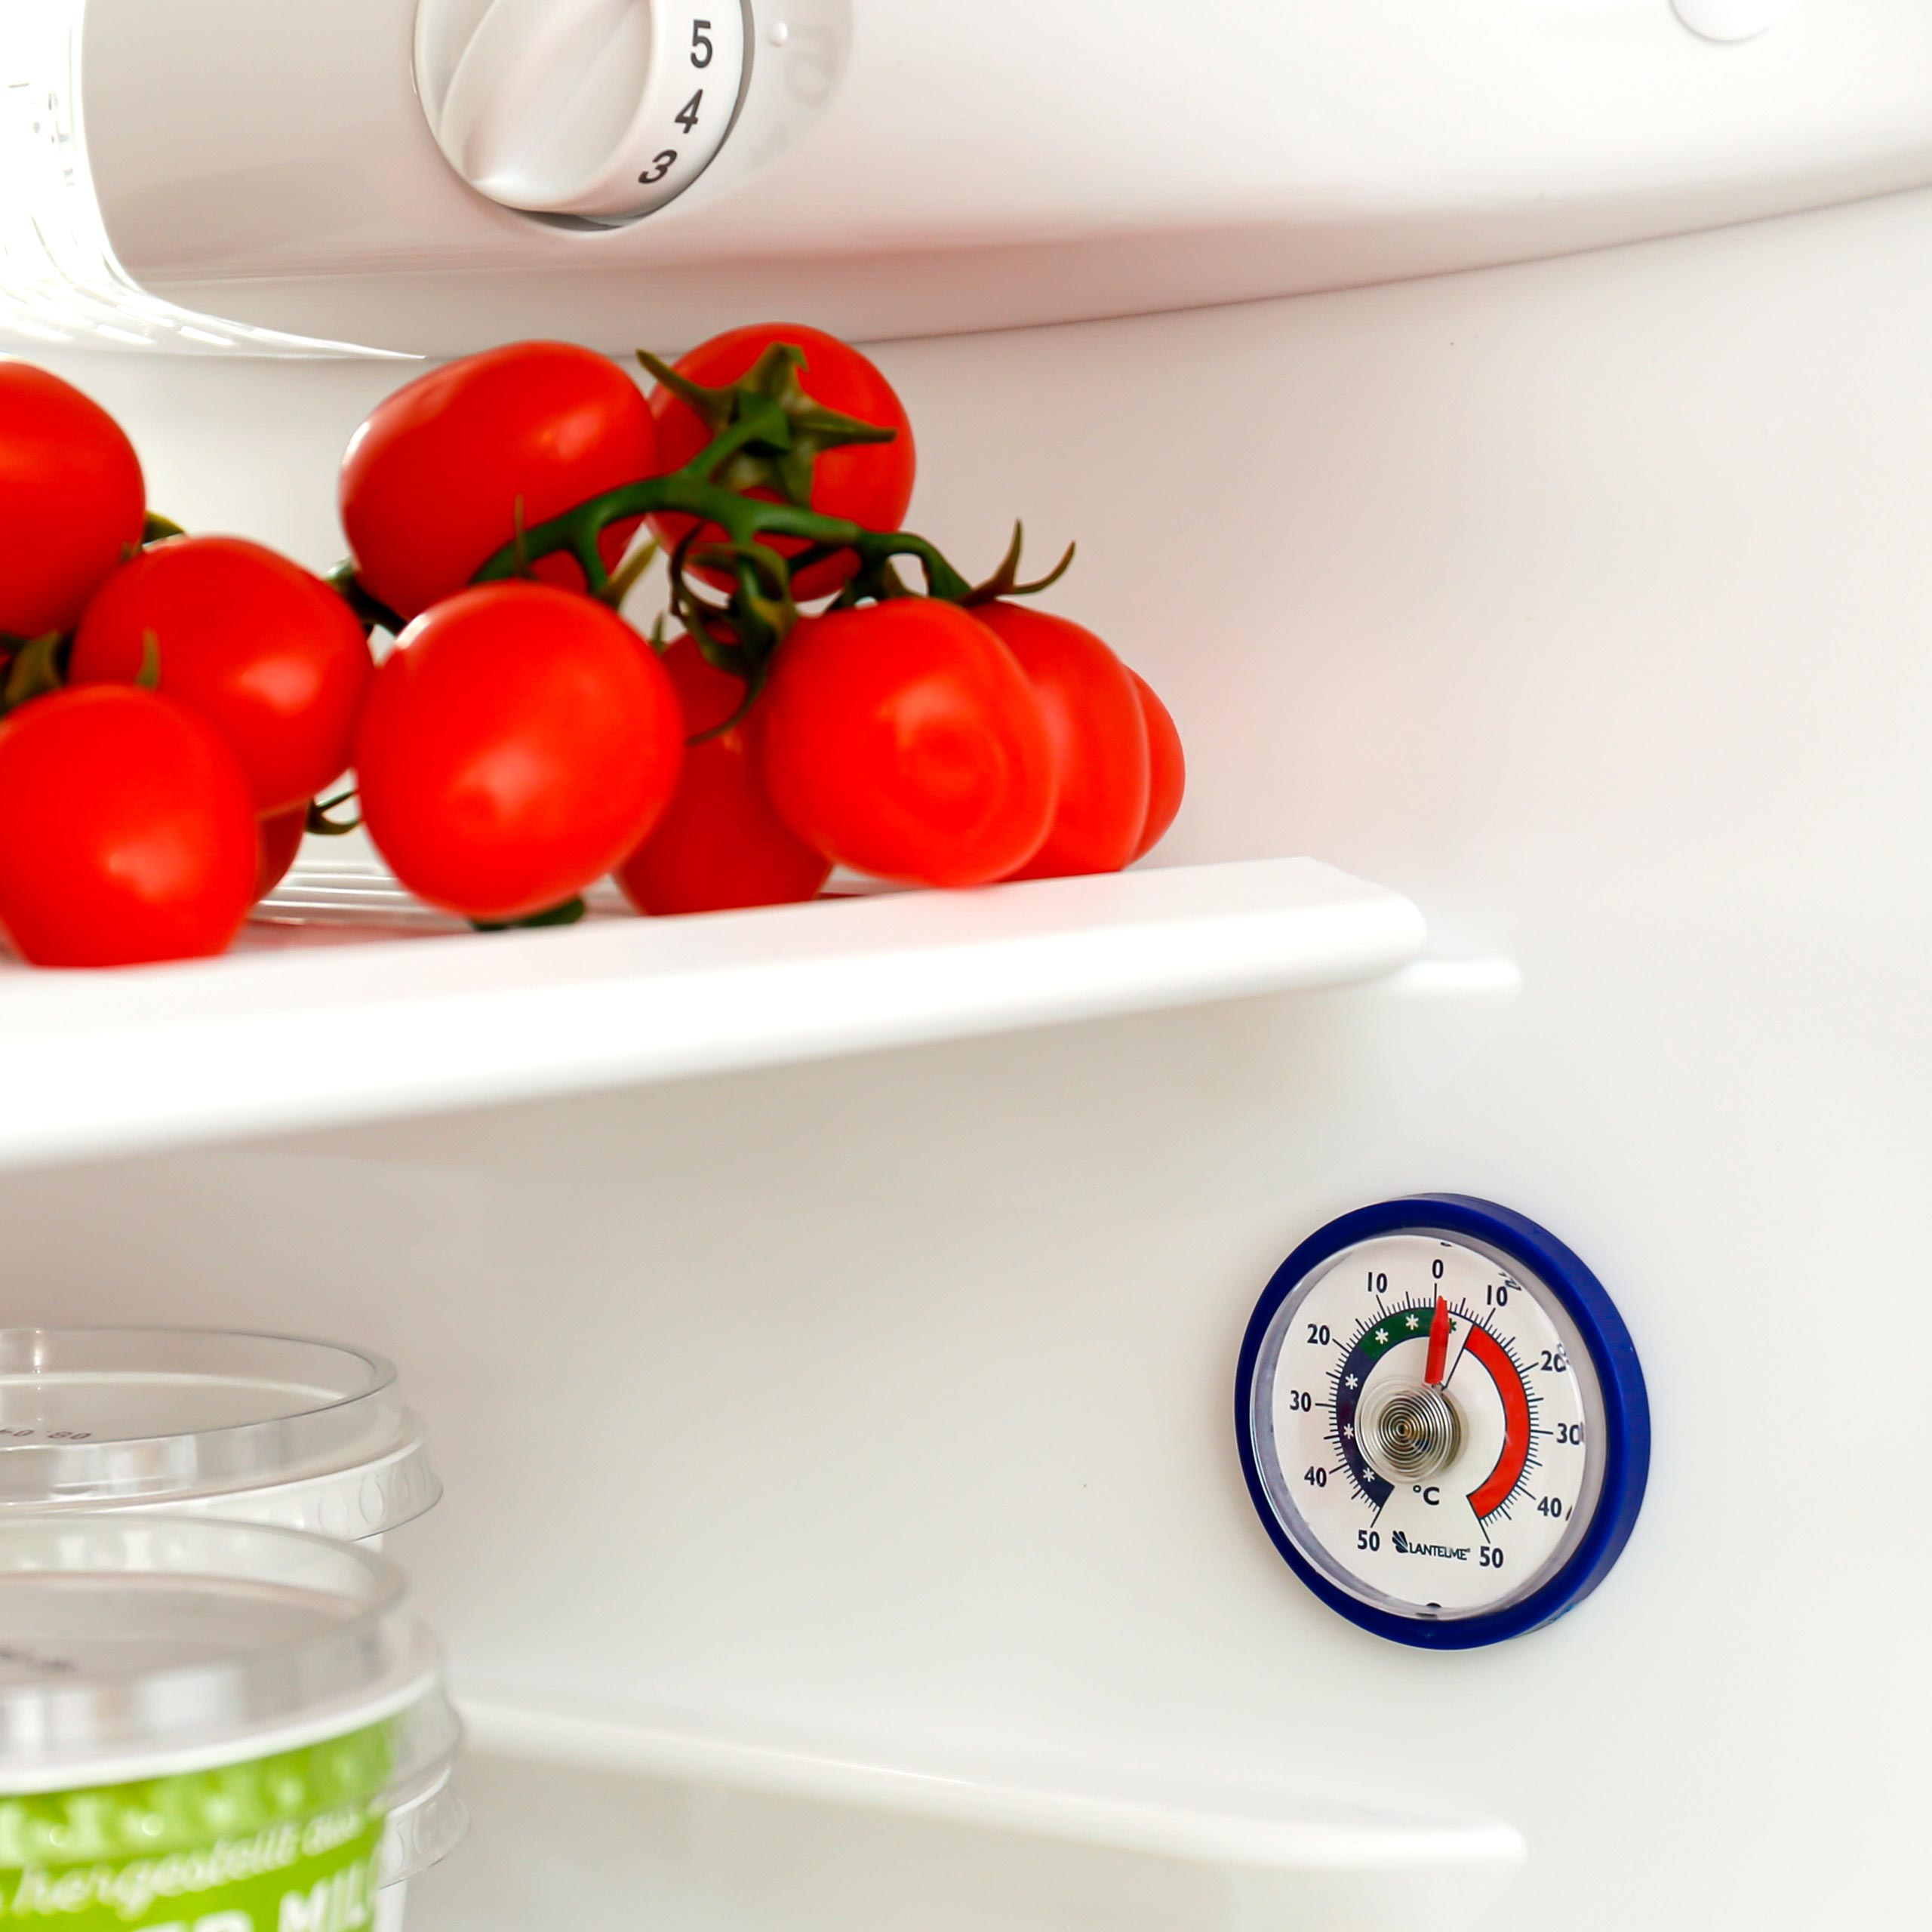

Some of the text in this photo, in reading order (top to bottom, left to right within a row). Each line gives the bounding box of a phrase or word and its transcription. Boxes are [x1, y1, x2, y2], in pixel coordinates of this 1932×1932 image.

[690, 19, 713, 69] 5
[674, 88, 704, 134] 4
[638, 149, 678, 184] 3
[1432, 1259, 1444, 1279] 0
[1367, 1272, 1388, 1294] 10
[1487, 1284, 1508, 1306] 10
[1306, 1323, 1331, 1346] 20
[1540, 1350, 1567, 1373] 20
[1289, 1390, 1312, 1412] 30
[1556, 1423, 1583, 1445] 30
[1304, 1466, 1327, 1487] 40
[1413, 1485, 1440, 1506] °C
[1537, 1496, 1562, 1518] 40
[1357, 1530, 1380, 1552] 50
[1479, 1546, 1504, 1568] 50
